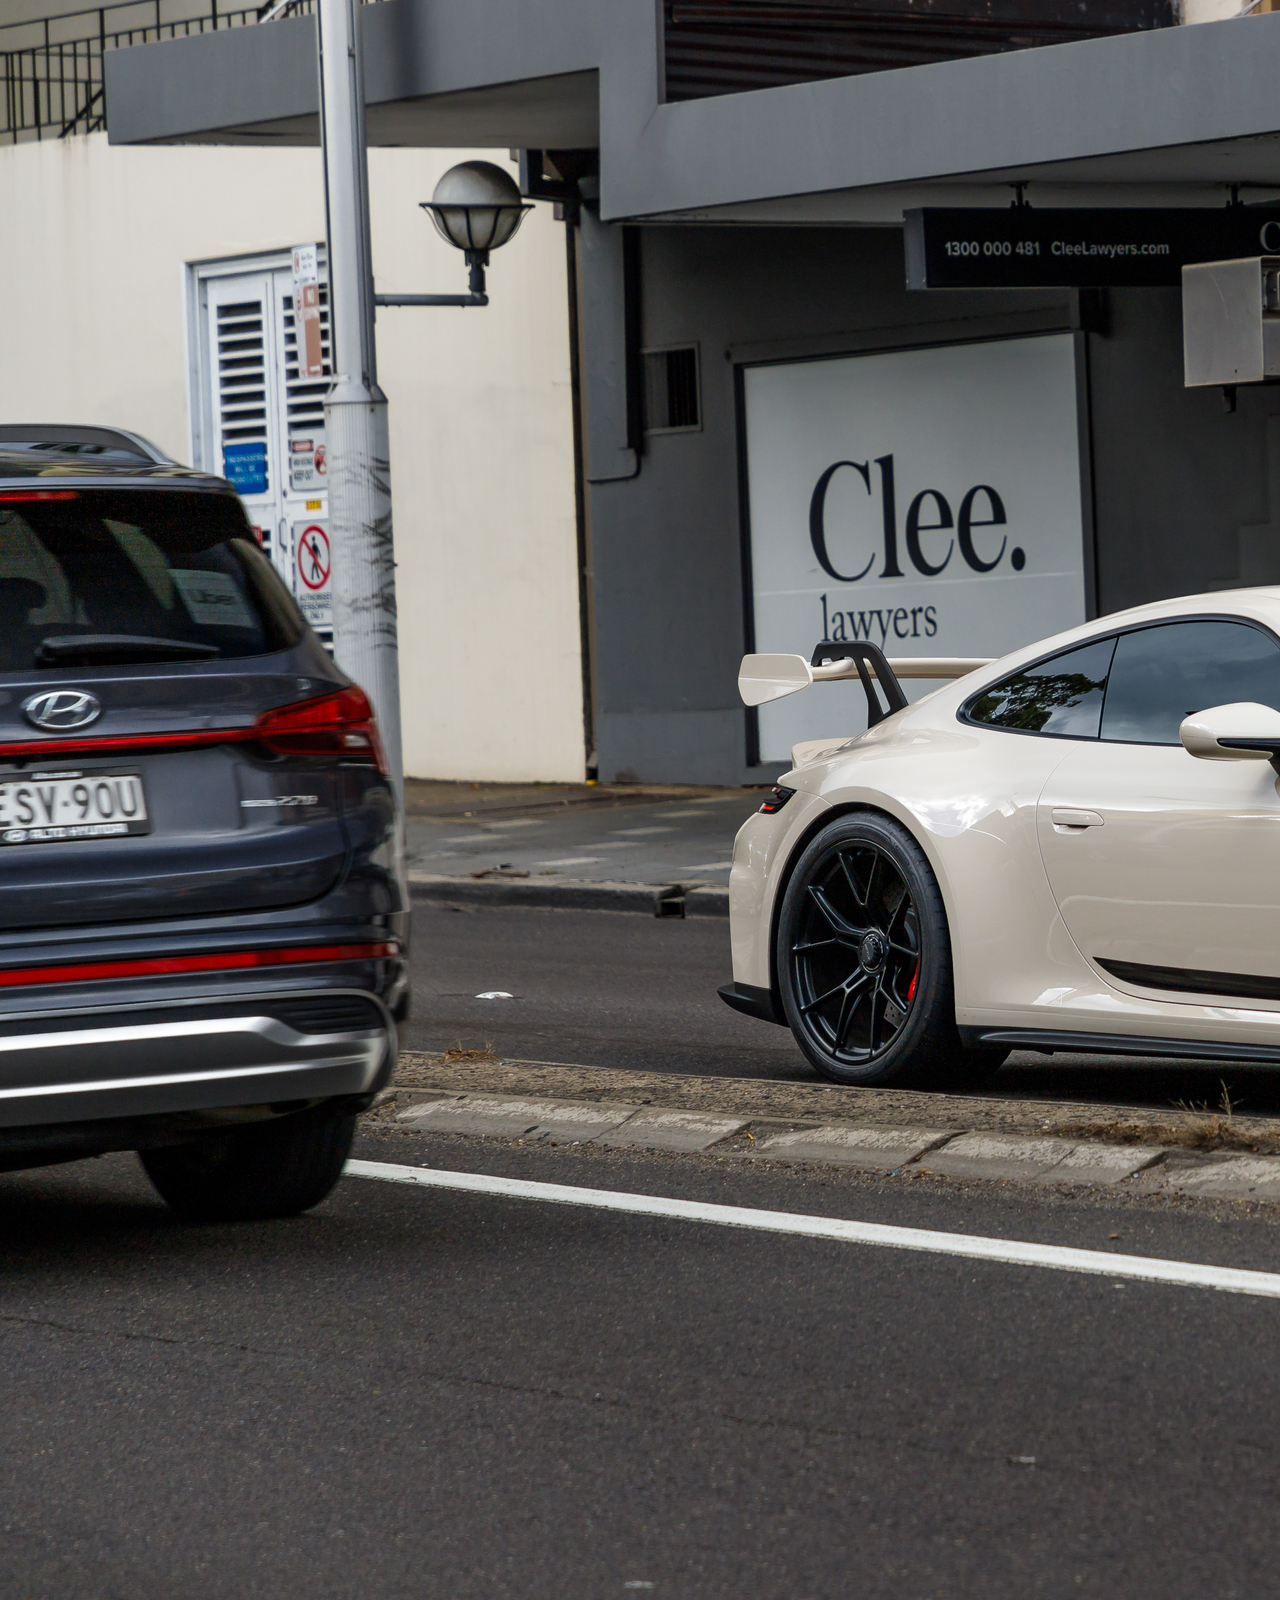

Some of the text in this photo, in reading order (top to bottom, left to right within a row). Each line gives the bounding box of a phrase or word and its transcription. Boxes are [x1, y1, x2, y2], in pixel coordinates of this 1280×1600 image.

[945, 240, 1170, 258] 1300 000 481 CleeLawyers.com
[809, 453, 1026, 582] Clee.
[819, 594, 938, 651] lawyers
